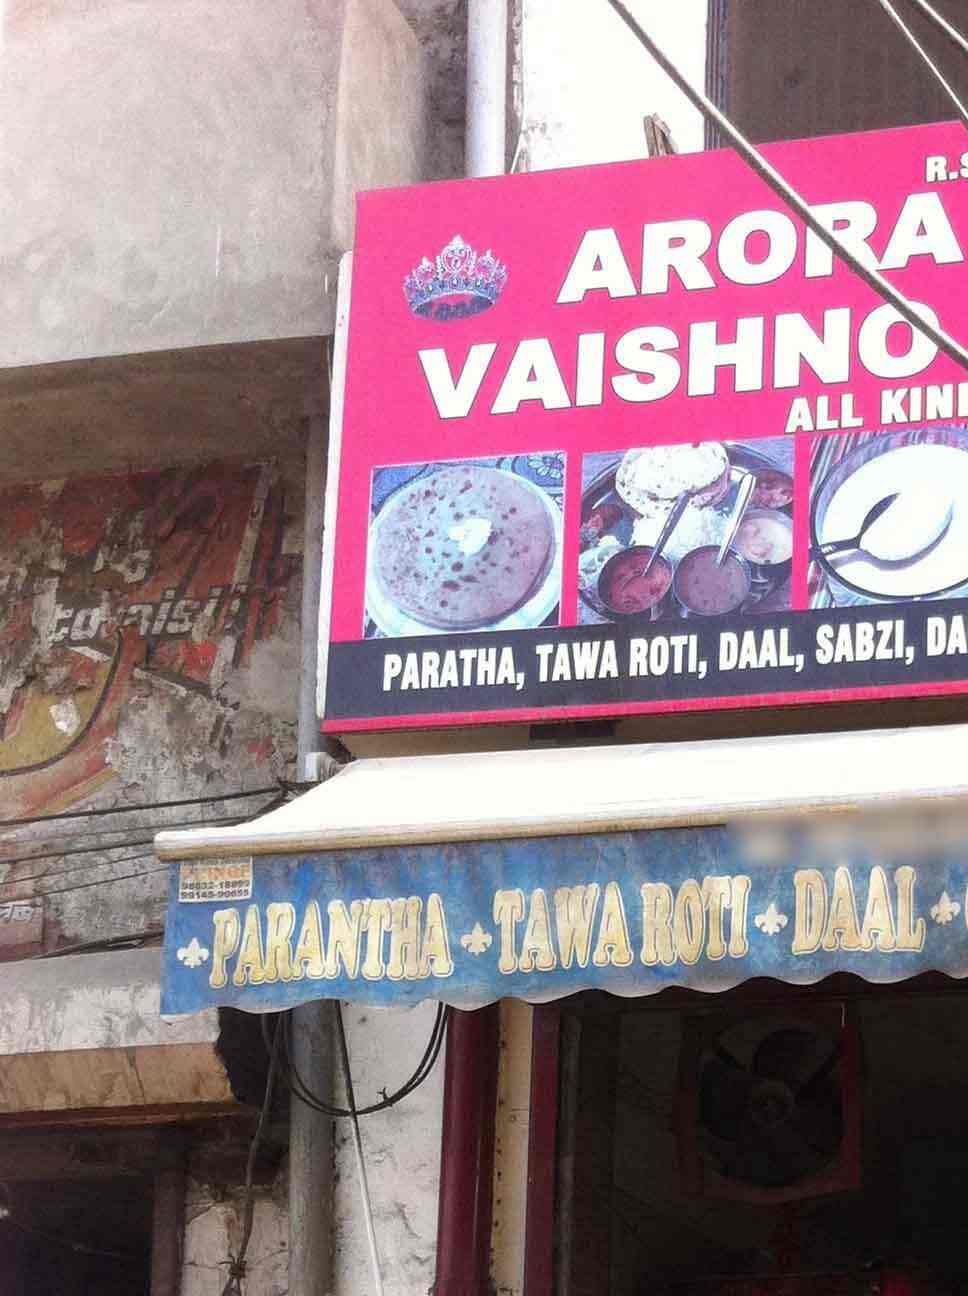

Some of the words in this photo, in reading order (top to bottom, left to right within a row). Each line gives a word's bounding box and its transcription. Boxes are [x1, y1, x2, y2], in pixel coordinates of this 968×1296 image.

[556, 192, 964, 303] ARORA
[418, 300, 940, 420] VAISHNO
[786, 394, 865, 432] ALL
[383, 646, 524, 691] PARATHA,
[537, 641, 618, 683] TAWA
[629, 635, 707, 680] ROTI,
[718, 628, 804, 671] DAAL,
[816, 620, 913, 664] SABZI,
[208, 892, 454, 988] PARANTHA
[492, 882, 632, 974] TAWA
[639, 874, 752, 966] ROTI
[792, 864, 926, 955] DAAL
